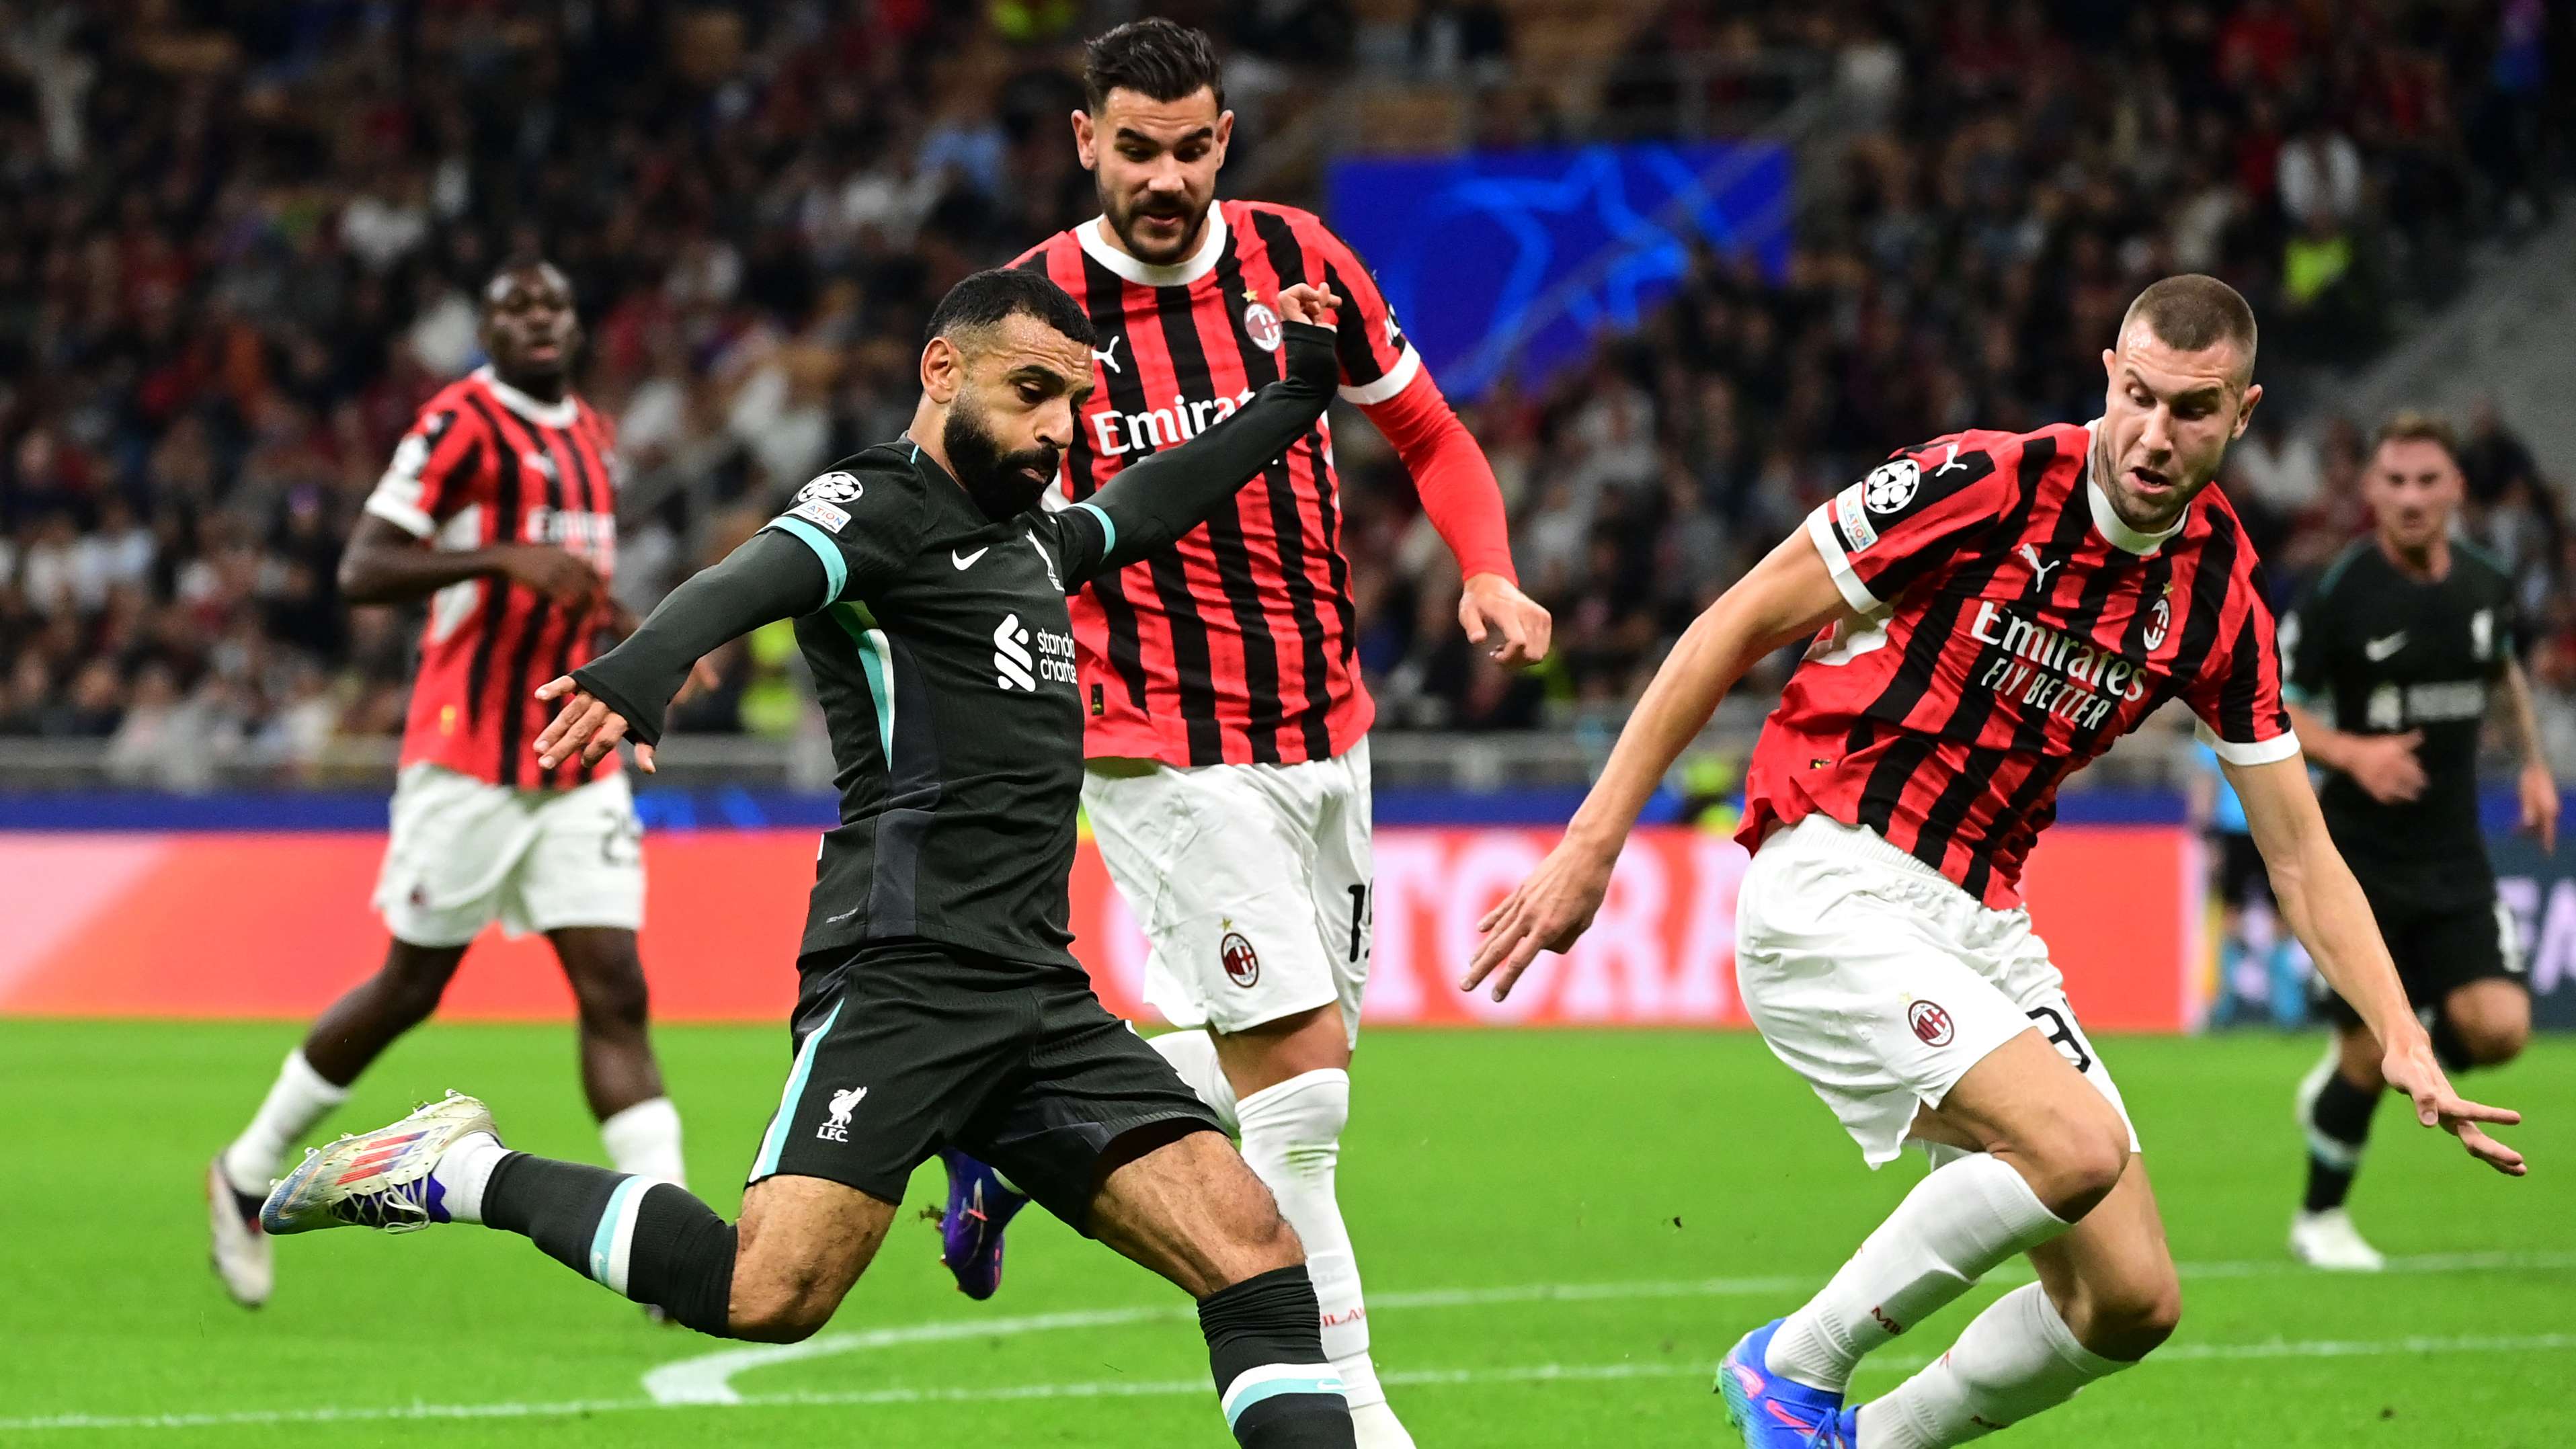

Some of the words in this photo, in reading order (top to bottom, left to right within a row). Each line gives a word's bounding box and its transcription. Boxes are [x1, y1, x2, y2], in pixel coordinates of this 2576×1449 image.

[1090, 387, 1256, 456] Emirat
[808, 505, 844, 526] ATION
[1037, 628, 1076, 659] standa
[1971, 601, 2147, 702] Emirates
[1040, 655, 1078, 684] charte
[1981, 657, 2030, 696] FLY
[2023, 672, 2111, 730] BETTER
